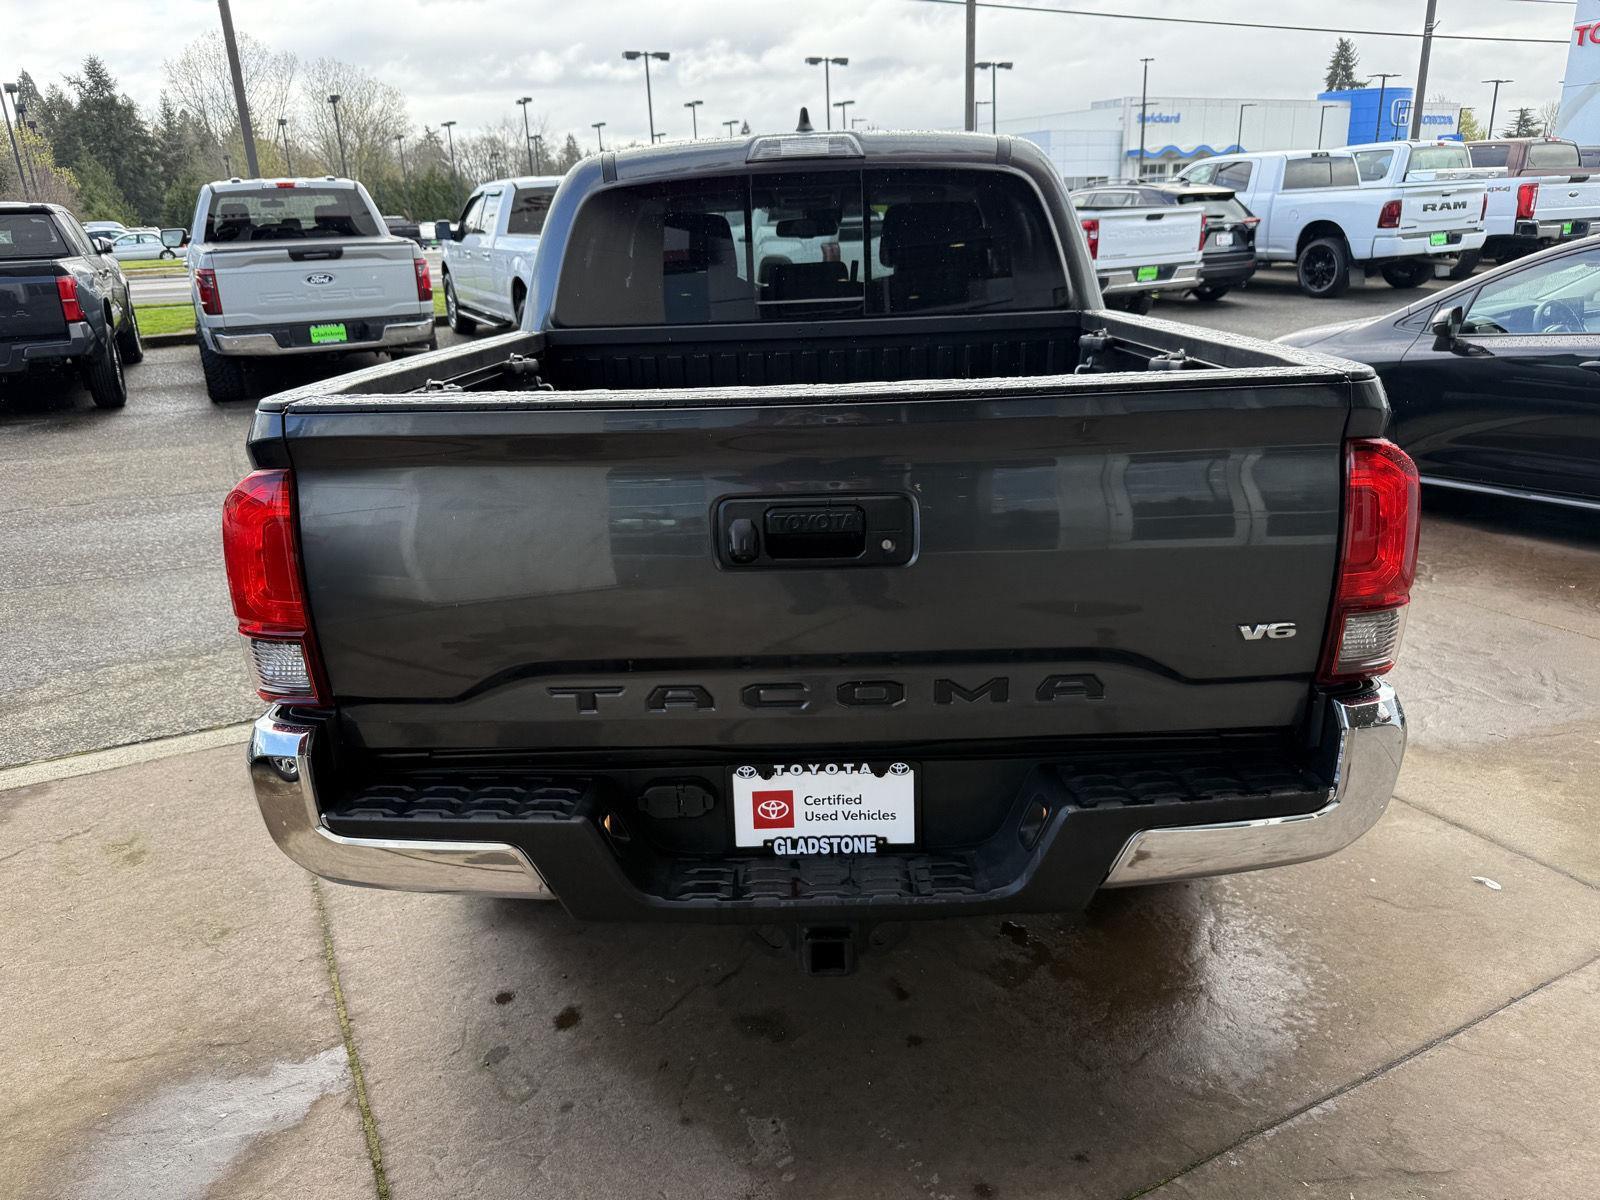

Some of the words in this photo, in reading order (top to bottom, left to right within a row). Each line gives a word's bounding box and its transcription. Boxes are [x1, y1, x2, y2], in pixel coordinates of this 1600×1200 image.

[1422, 201, 1468, 213] RAM
[308, 274, 333, 285] Ford
[770, 513, 857, 530] TOYOTA
[1238, 622, 1297, 641] V6
[545, 673, 1106, 715] TACOMA
[773, 763, 872, 777] TOYOTA
[803, 794, 862, 806] Certified
[804, 810, 838, 821] Used
[842, 809, 897, 821] Vehicles
[773, 837, 877, 855] GLADSTONE
